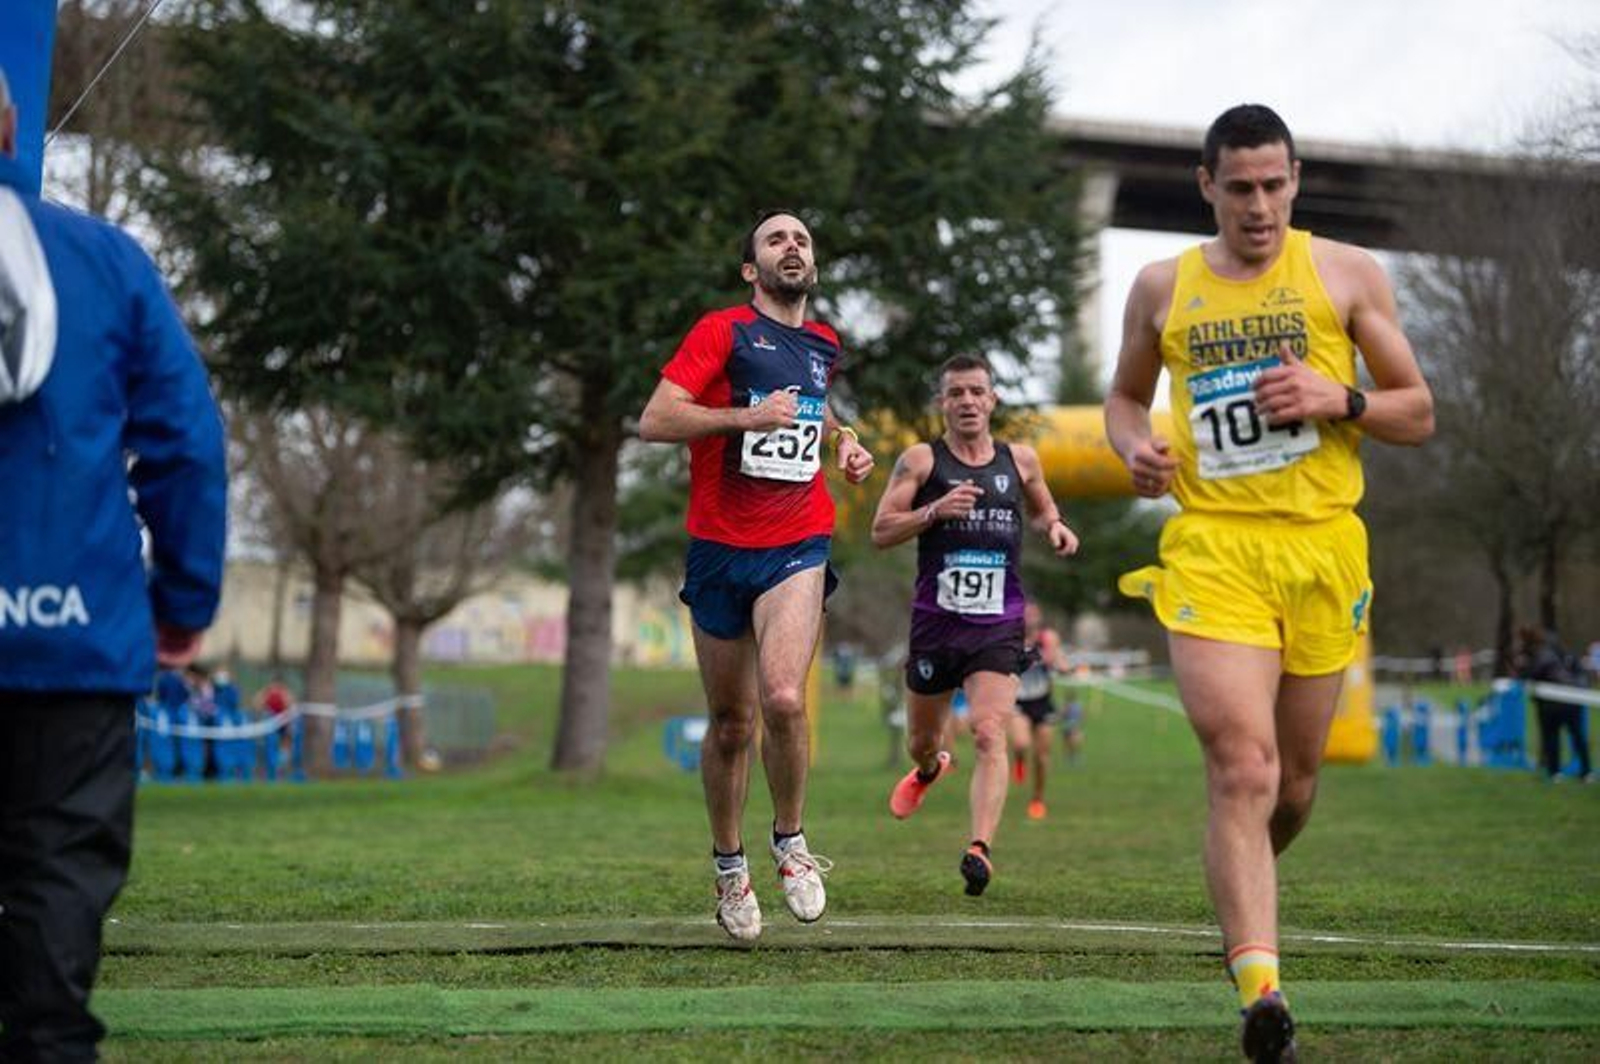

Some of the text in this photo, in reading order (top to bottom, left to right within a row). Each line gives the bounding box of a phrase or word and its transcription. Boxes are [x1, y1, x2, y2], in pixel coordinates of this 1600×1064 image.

[1189, 311, 1305, 344] ATHLETICS
[1230, 335, 1306, 362] LAZAO
[751, 424, 818, 462] 252
[969, 509, 1013, 521] DE FOZ
[950, 570, 995, 599] 191
[0, 584, 90, 627] NCA
